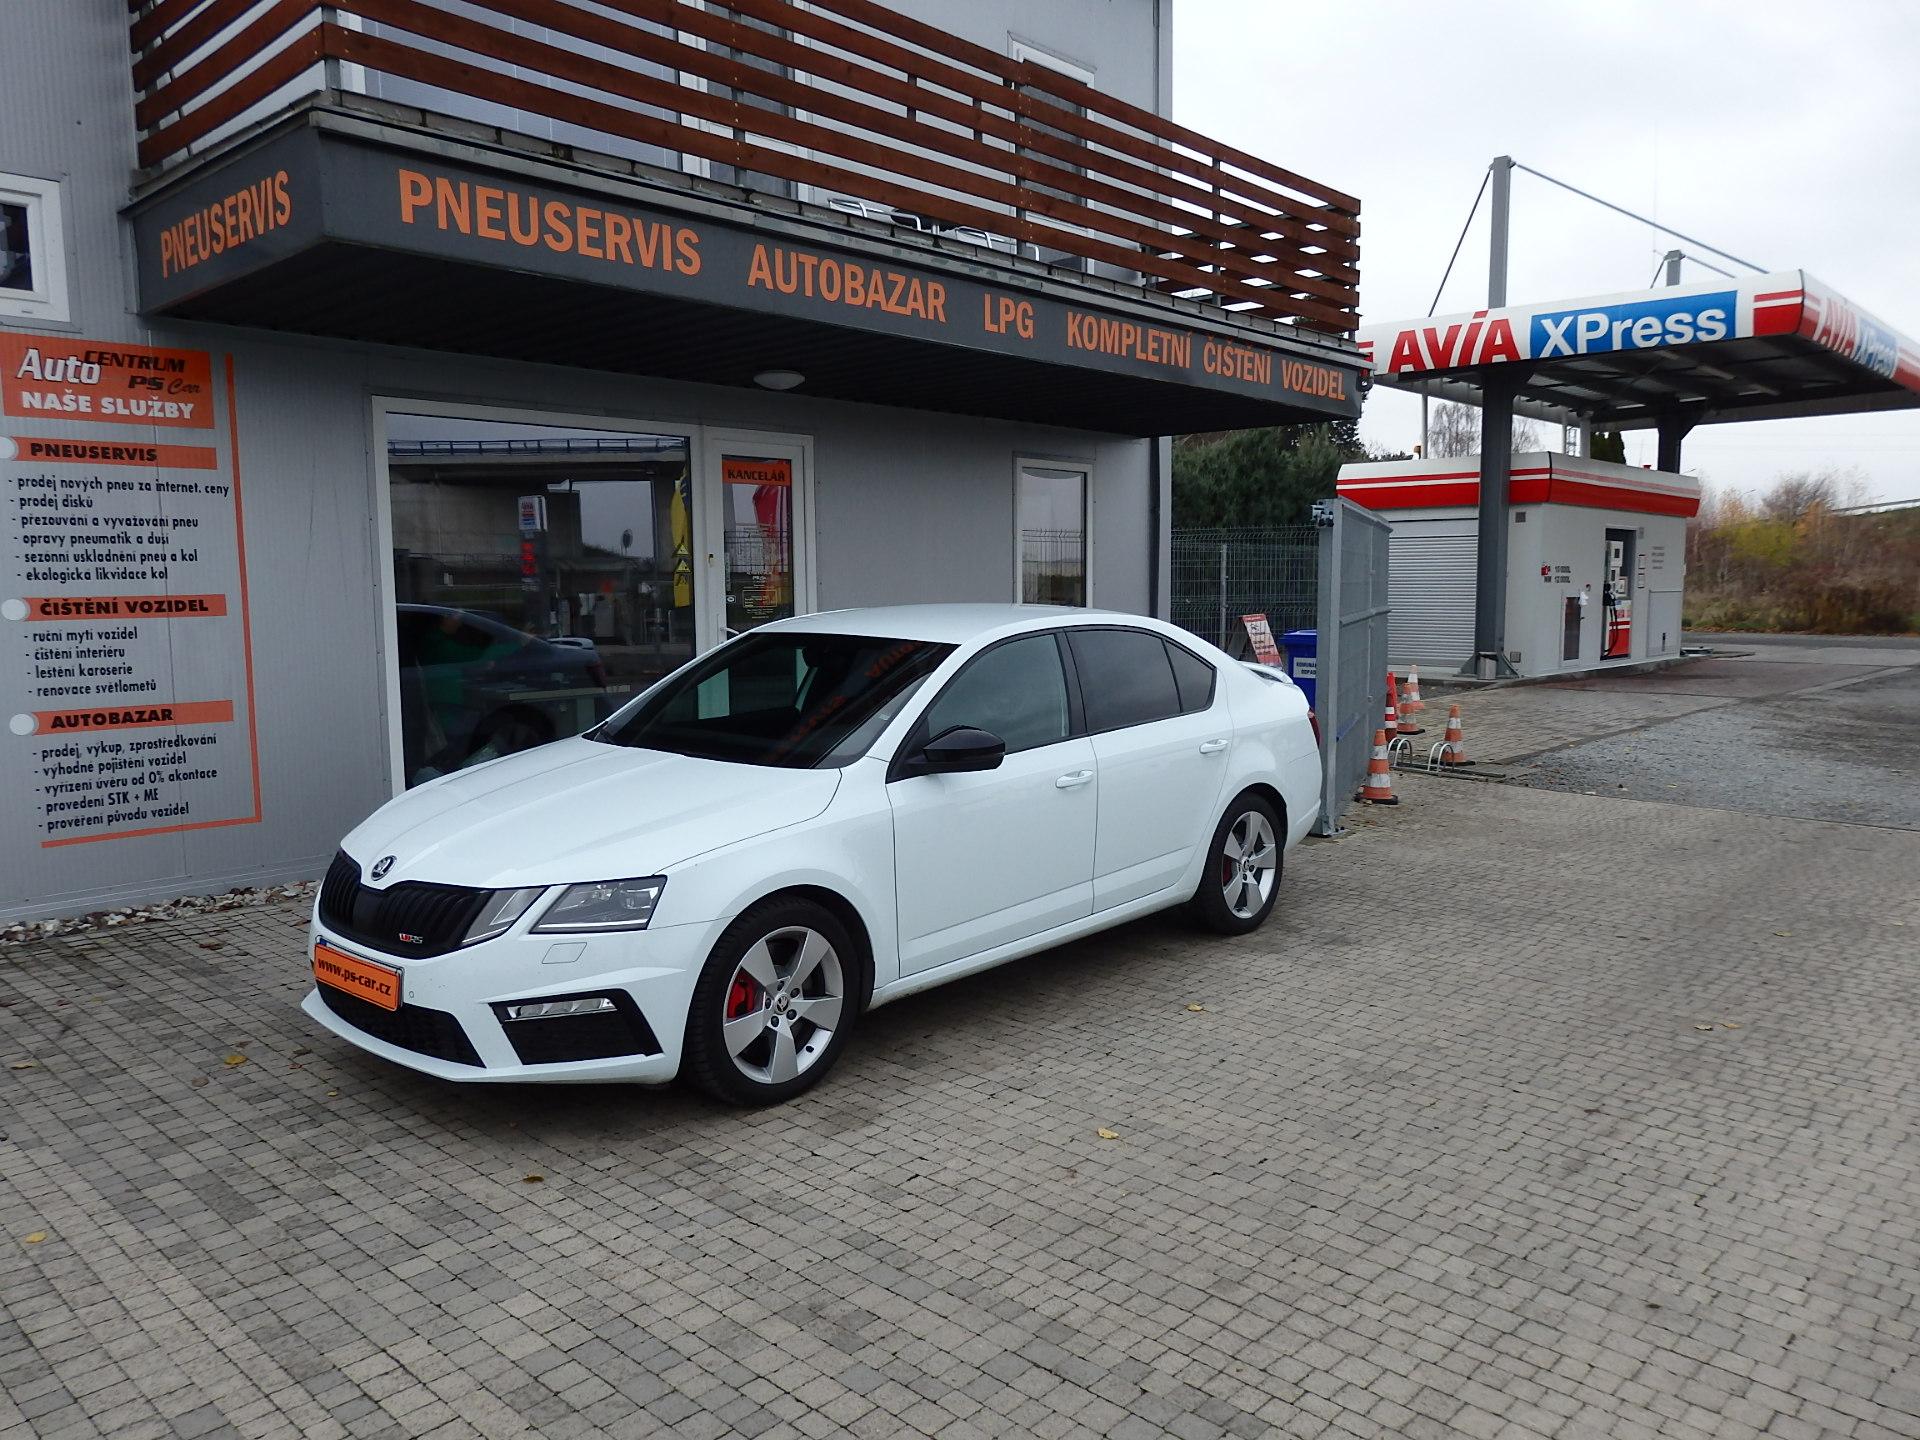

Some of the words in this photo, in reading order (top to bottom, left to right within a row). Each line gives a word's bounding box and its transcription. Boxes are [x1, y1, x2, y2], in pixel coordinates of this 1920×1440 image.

[160, 170, 291, 278] PNEUSERVIS
[399, 169, 701, 276] PNEUSERVIS
[746, 243, 947, 323] AUTOBAZAR
[984, 293, 1034, 339] LPG
[1067, 312, 1193, 368] KOMPLETNÍ
[1203, 334, 1272, 385] ČIŠTĚNÍ
[1282, 359, 1346, 401] VOZIDEL
[1540, 308, 1727, 356] XPress
[16, 347, 102, 385] Auto
[84, 350, 186, 373] CENTRUM
[128, 375, 165, 391] PS
[168, 378, 201, 394] Car
[21, 389, 92, 413] NAŠE
[101, 395, 194, 419] SLUŽBY
[31, 442, 158, 462] PNEUSERVIS
[18, 474, 57, 491] prodej
[61, 476, 102, 492] nových
[107, 481, 134, 493] pneu
[138, 482, 151, 491] za
[205, 485, 229, 497] ceny
[19, 494, 58, 510] prodej
[62, 494, 93, 507] disků
[92, 517, 99, 526] a
[173, 518, 198, 530] pneu
[23, 535, 65, 547] opravy
[70, 531, 131, 547] pneumatik
[136, 536, 143, 544] a
[140, 553, 167, 565] pneu
[171, 554, 177, 562] a
[181, 548, 198, 561] kol
[26, 567, 91, 584] ekologická
[96, 567, 147, 580] likvidace
[151, 566, 168, 579] kol
[40, 597, 118, 616] ČIŠTĚNÍ
[124, 599, 208, 614] VOZIDEL
[33, 629, 62, 642] ruční
[97, 626, 138, 640] vozidel
[35, 646, 72, 660] čištění
[76, 645, 125, 658] interiéru
[36, 665, 75, 678] leštění
[79, 662, 133, 677] karoserie
[37, 686, 91, 697] renovace
[96, 679, 157, 694] světlometů
[50, 708, 174, 729] AUTOBAZAR
[130, 733, 217, 753] zprostředkování
[43, 760, 94, 779] výhodné
[98, 756, 144, 774] pojištění
[148, 751, 187, 766] vozidel
[96, 776, 127, 789] úvěru
[132, 772, 145, 785] od
[149, 771, 165, 784] 0%
[169, 769, 217, 782] akontace
[46, 795, 104, 816] provedení
[108, 791, 130, 806] STK
[134, 793, 140, 801] +
[144, 788, 159, 801] ME
[47, 812, 103, 834] prověření
[107, 806, 147, 826] původu
[151, 801, 189, 818] vozidel
[318, 958, 392, 996] www.ps-car.cz
